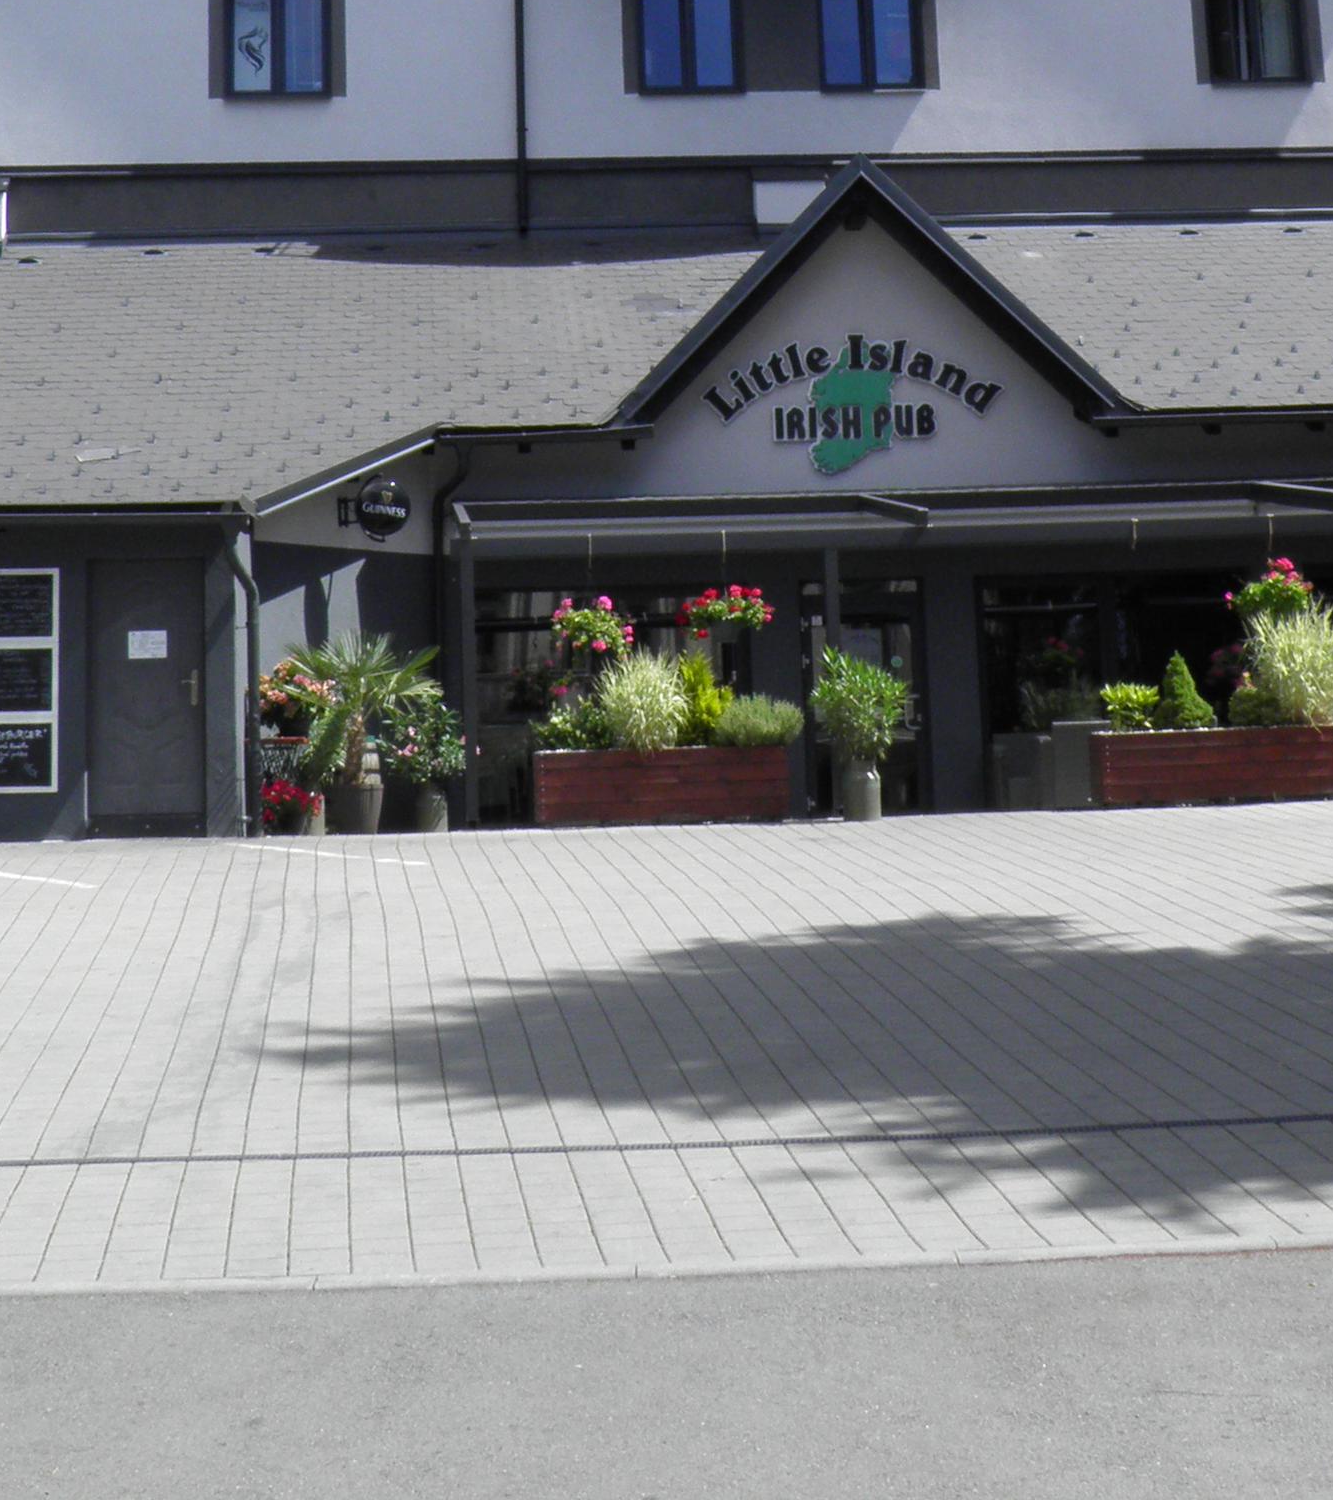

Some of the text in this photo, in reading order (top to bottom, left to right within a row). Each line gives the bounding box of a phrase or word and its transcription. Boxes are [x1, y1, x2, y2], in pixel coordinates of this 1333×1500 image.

[702, 334, 1004, 422] Little Island
[774, 404, 936, 440] IRISH PUB
[362, 502, 407, 518] GUINNESS
